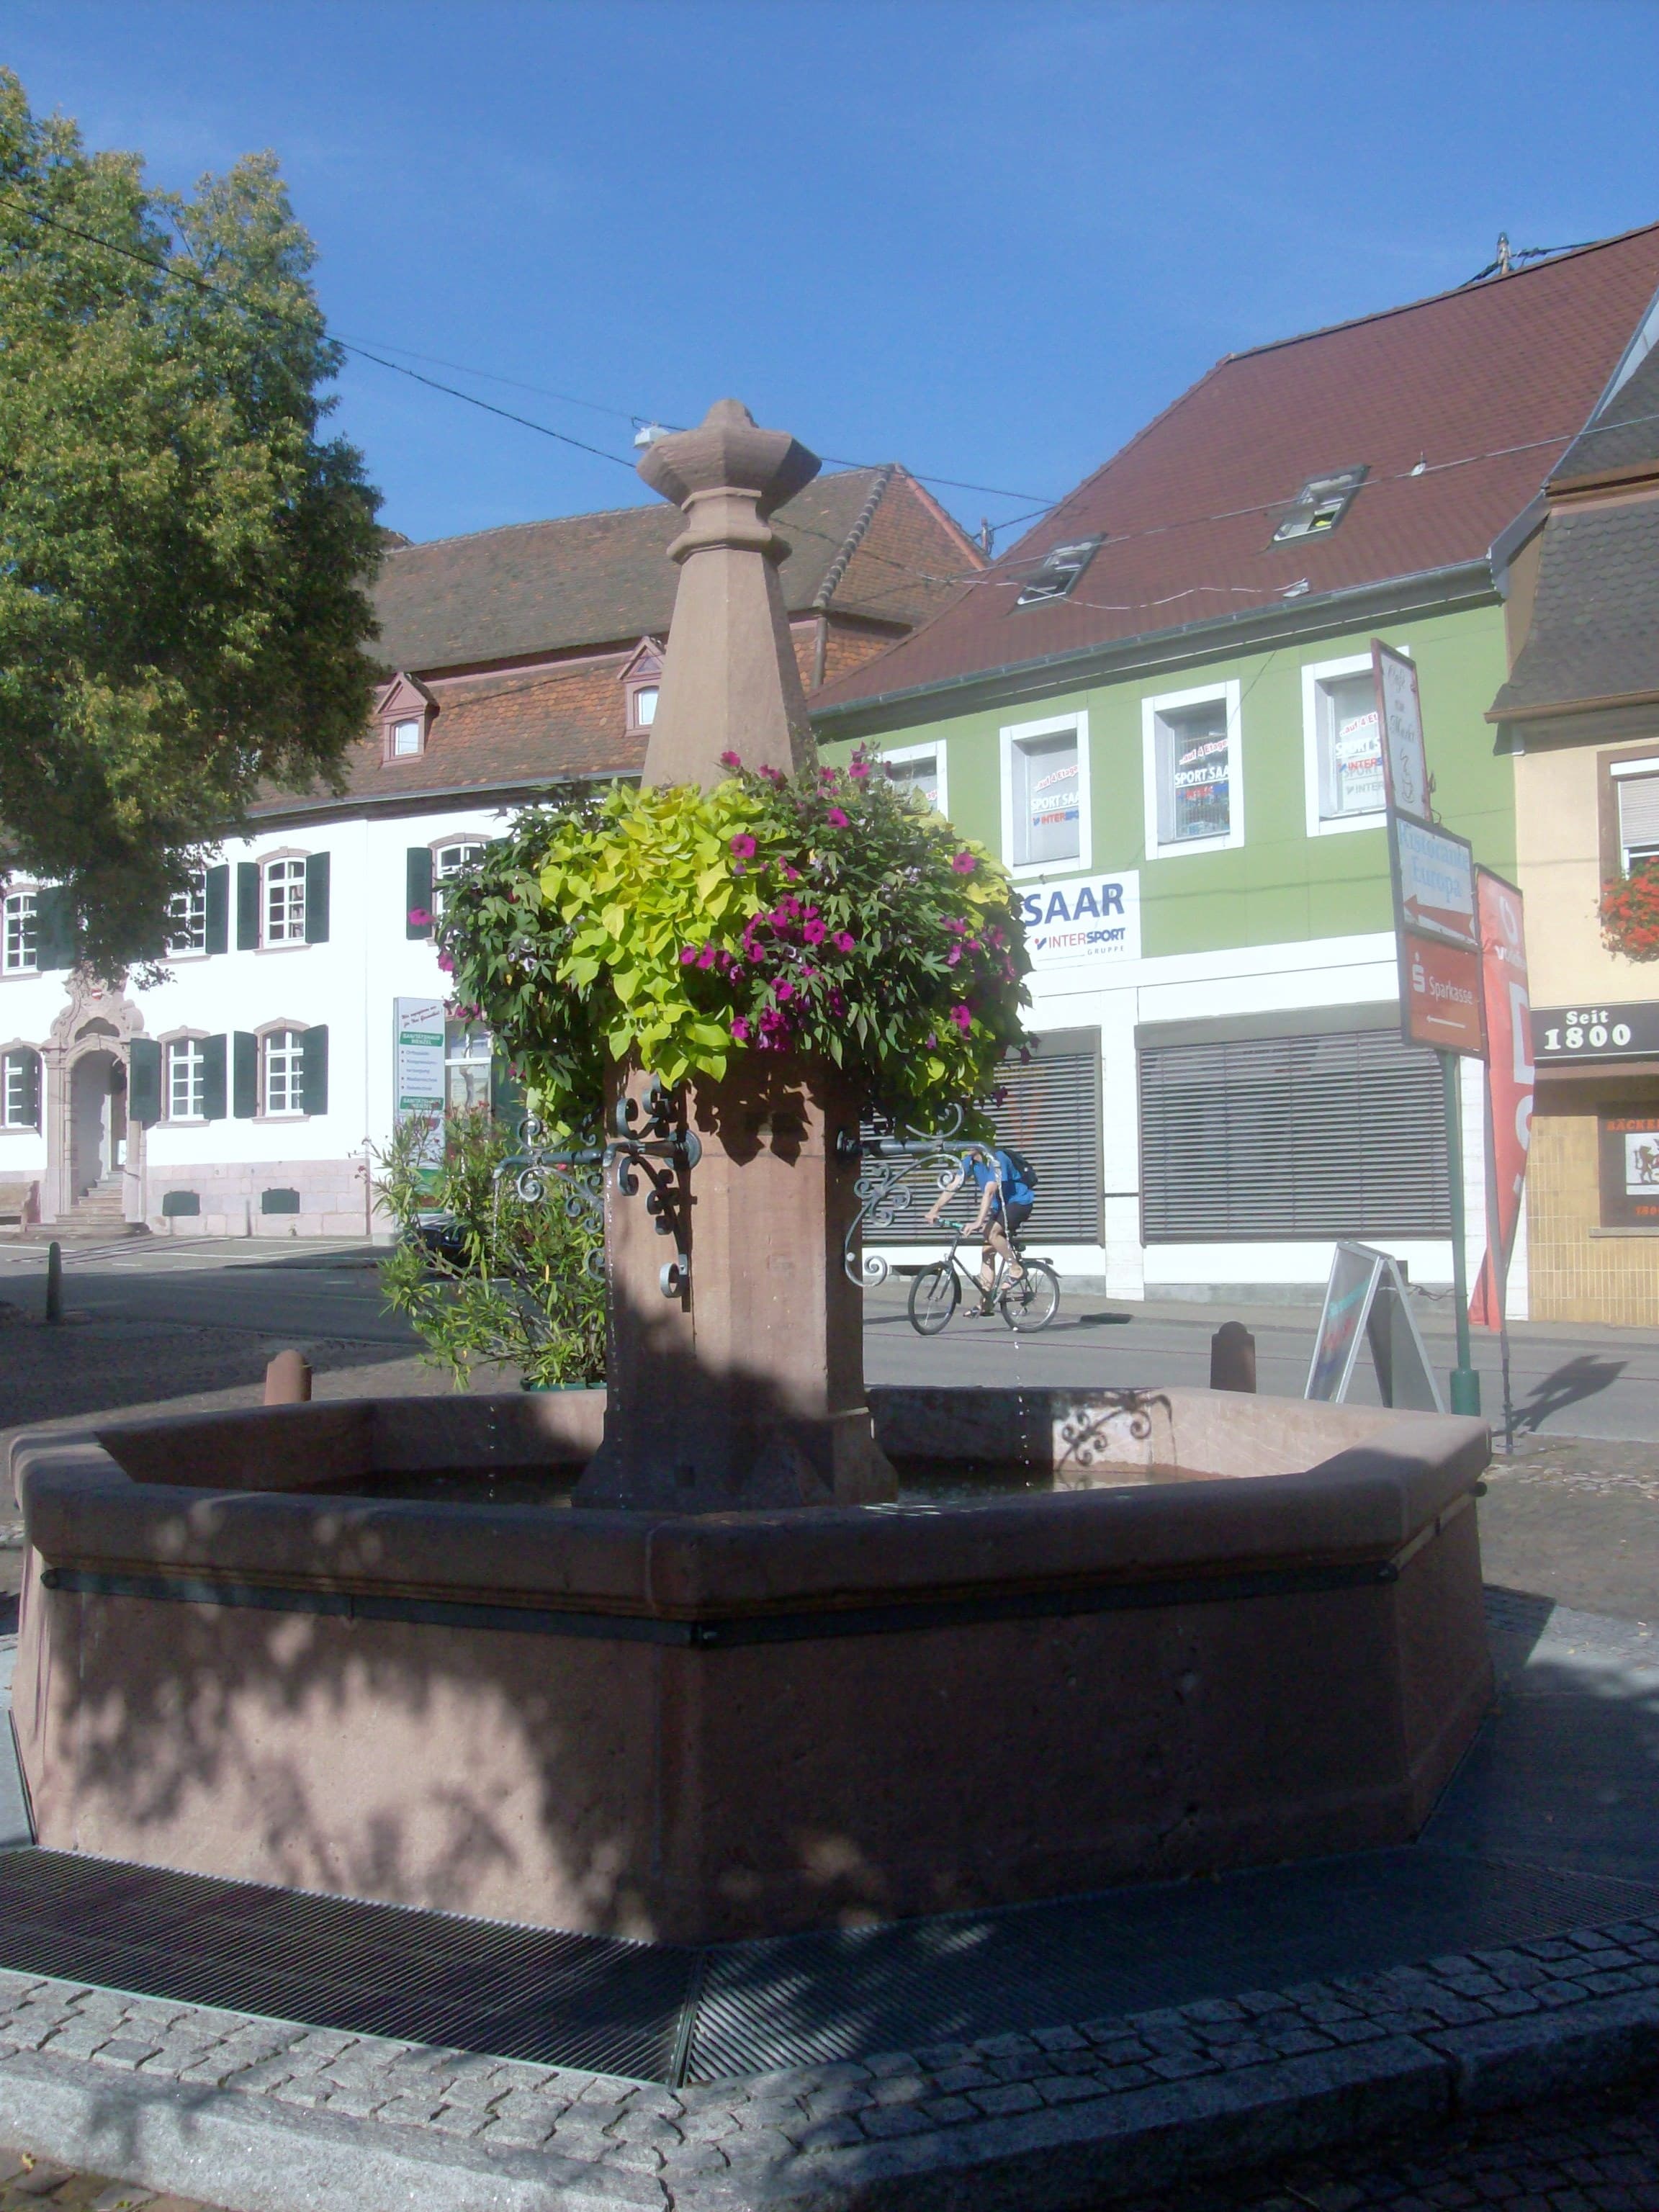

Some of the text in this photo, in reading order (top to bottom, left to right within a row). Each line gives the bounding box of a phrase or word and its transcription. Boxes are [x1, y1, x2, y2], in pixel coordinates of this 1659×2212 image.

[1174, 768, 1208, 784] SPORT
[1030, 795, 1061, 811] SPORT
[1411, 855, 1463, 903] Europa
[1023, 883, 1125, 927] SAAR
[1049, 927, 1125, 948] INTERSPORT
[1087, 945, 1124, 956] GRUPPE
[1429, 976, 1474, 1005] Sparkasse
[1565, 1010, 1609, 1025] Seit
[1544, 1023, 1631, 1050] 1800
